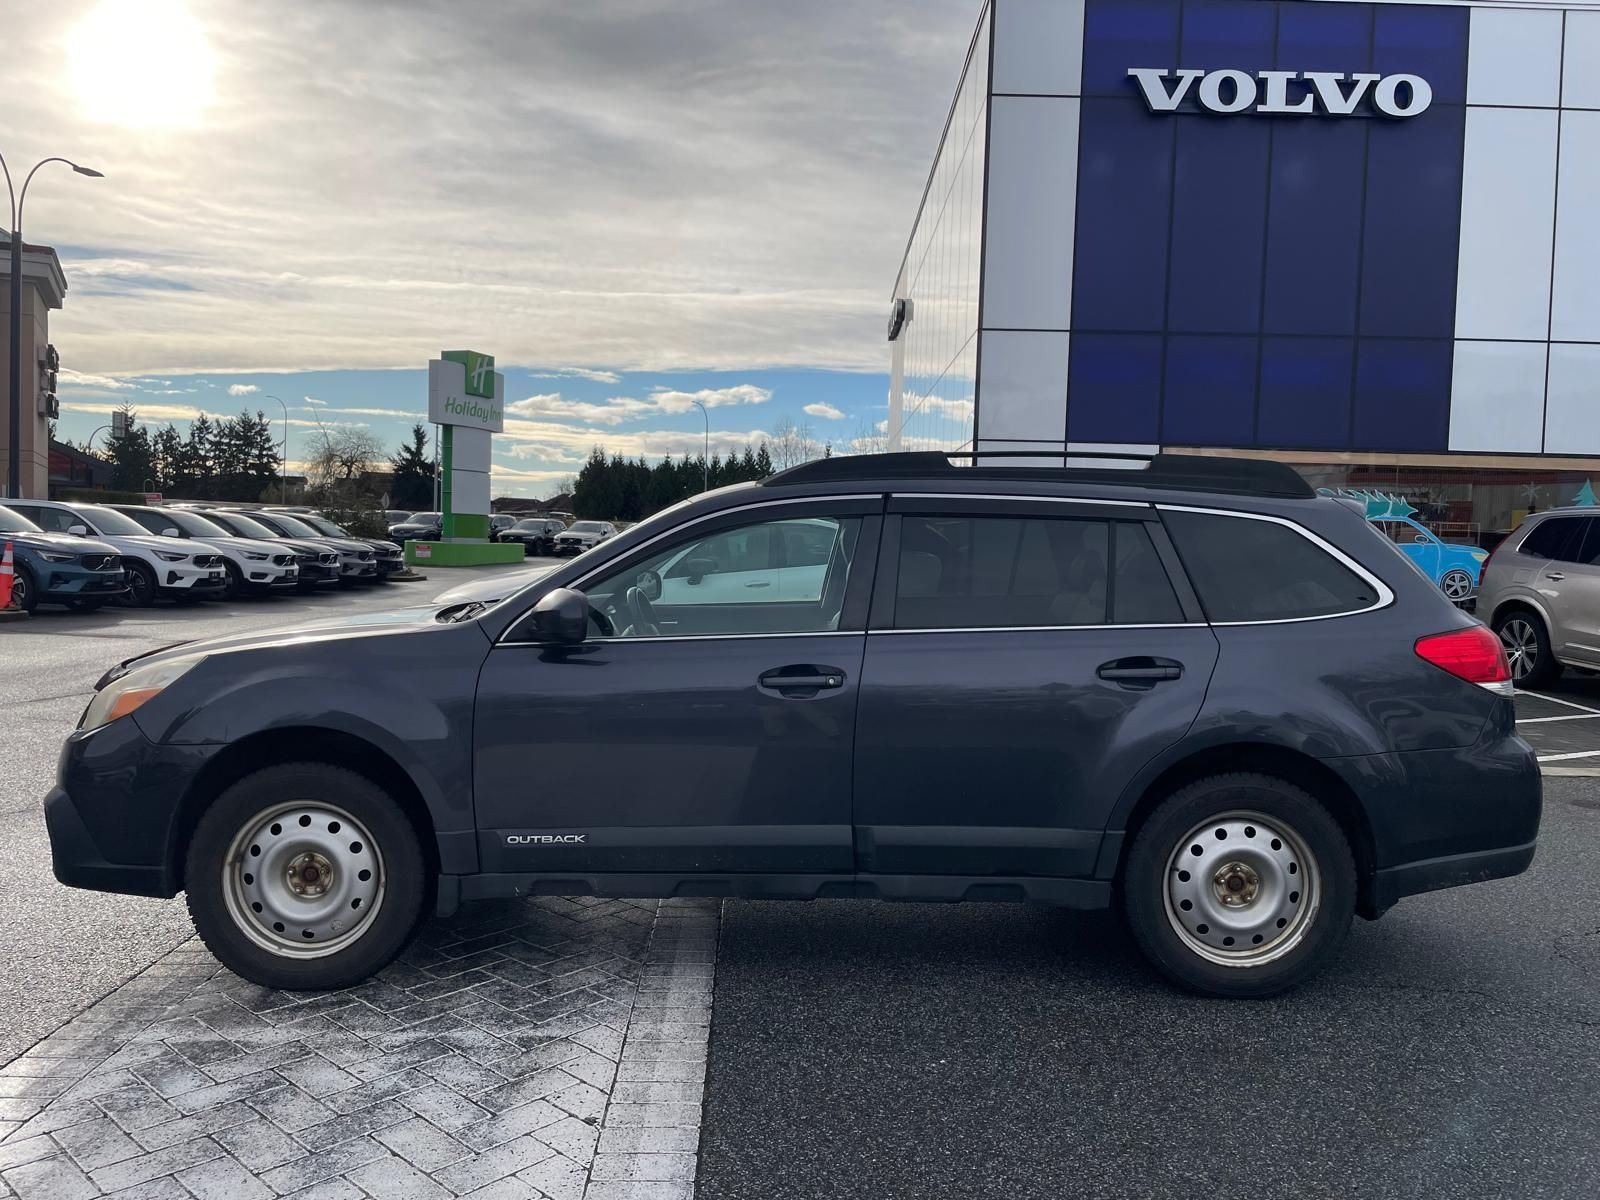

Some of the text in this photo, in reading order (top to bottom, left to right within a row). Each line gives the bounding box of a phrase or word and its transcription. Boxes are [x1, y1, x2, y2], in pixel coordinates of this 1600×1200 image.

[1127, 68, 1433, 117] VOLVO
[444, 397, 489, 423] Holiday
[506, 834, 587, 844] OUTBACK
